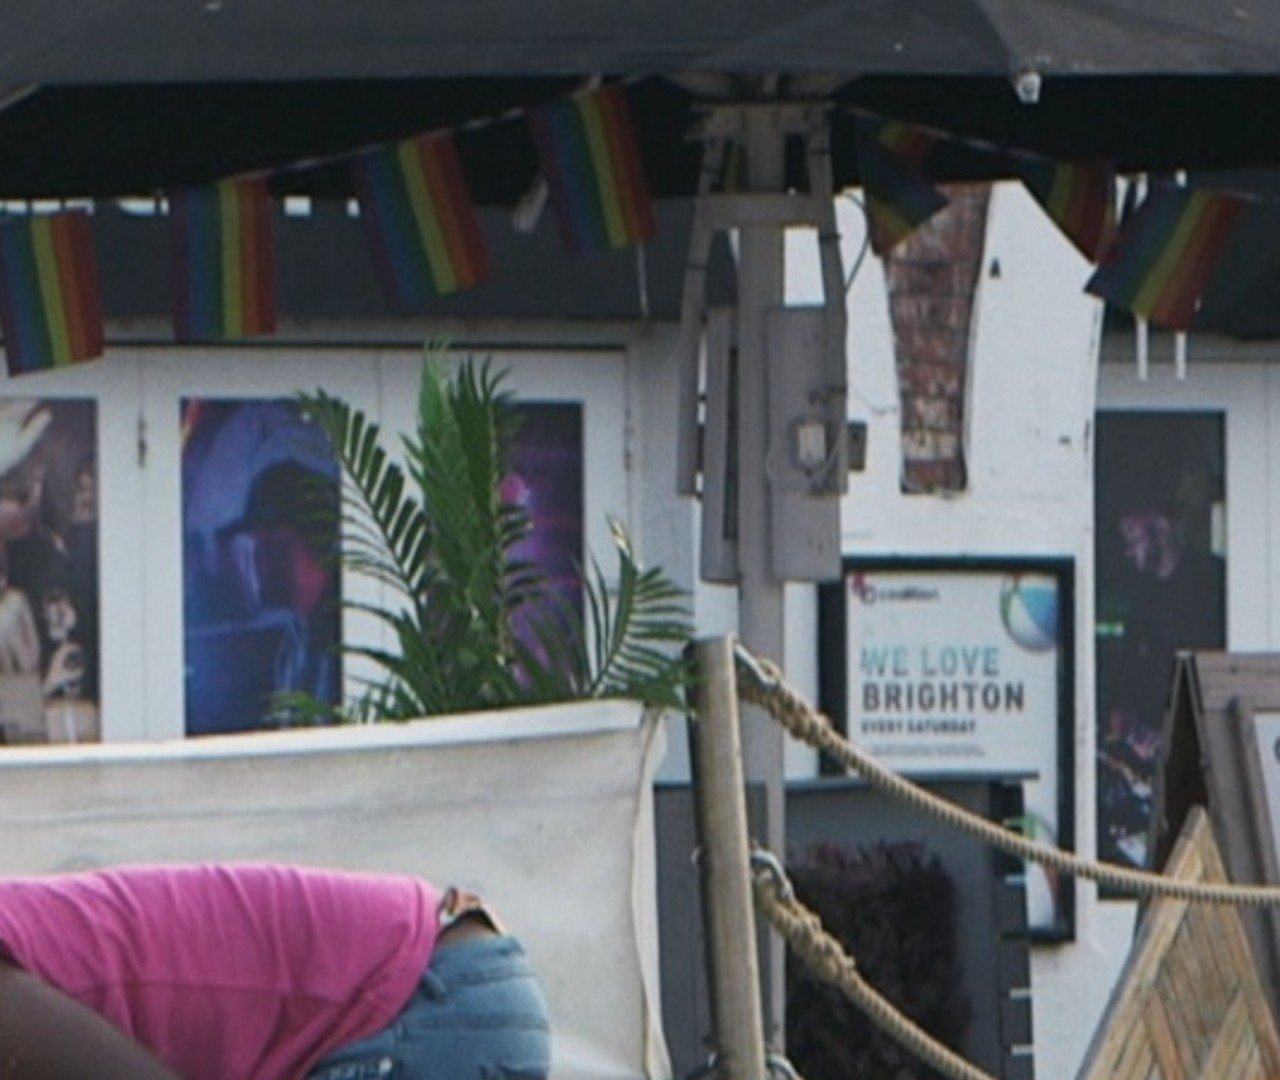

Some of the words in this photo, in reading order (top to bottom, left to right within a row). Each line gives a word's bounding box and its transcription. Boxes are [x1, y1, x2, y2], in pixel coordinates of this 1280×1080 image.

[860, 647, 907, 676] WE
[922, 647, 999, 676] LOVE
[862, 682, 1024, 712] BRIGHTON
[861, 719, 903, 734] EVERY
[907, 719, 976, 734] SATURDAY
